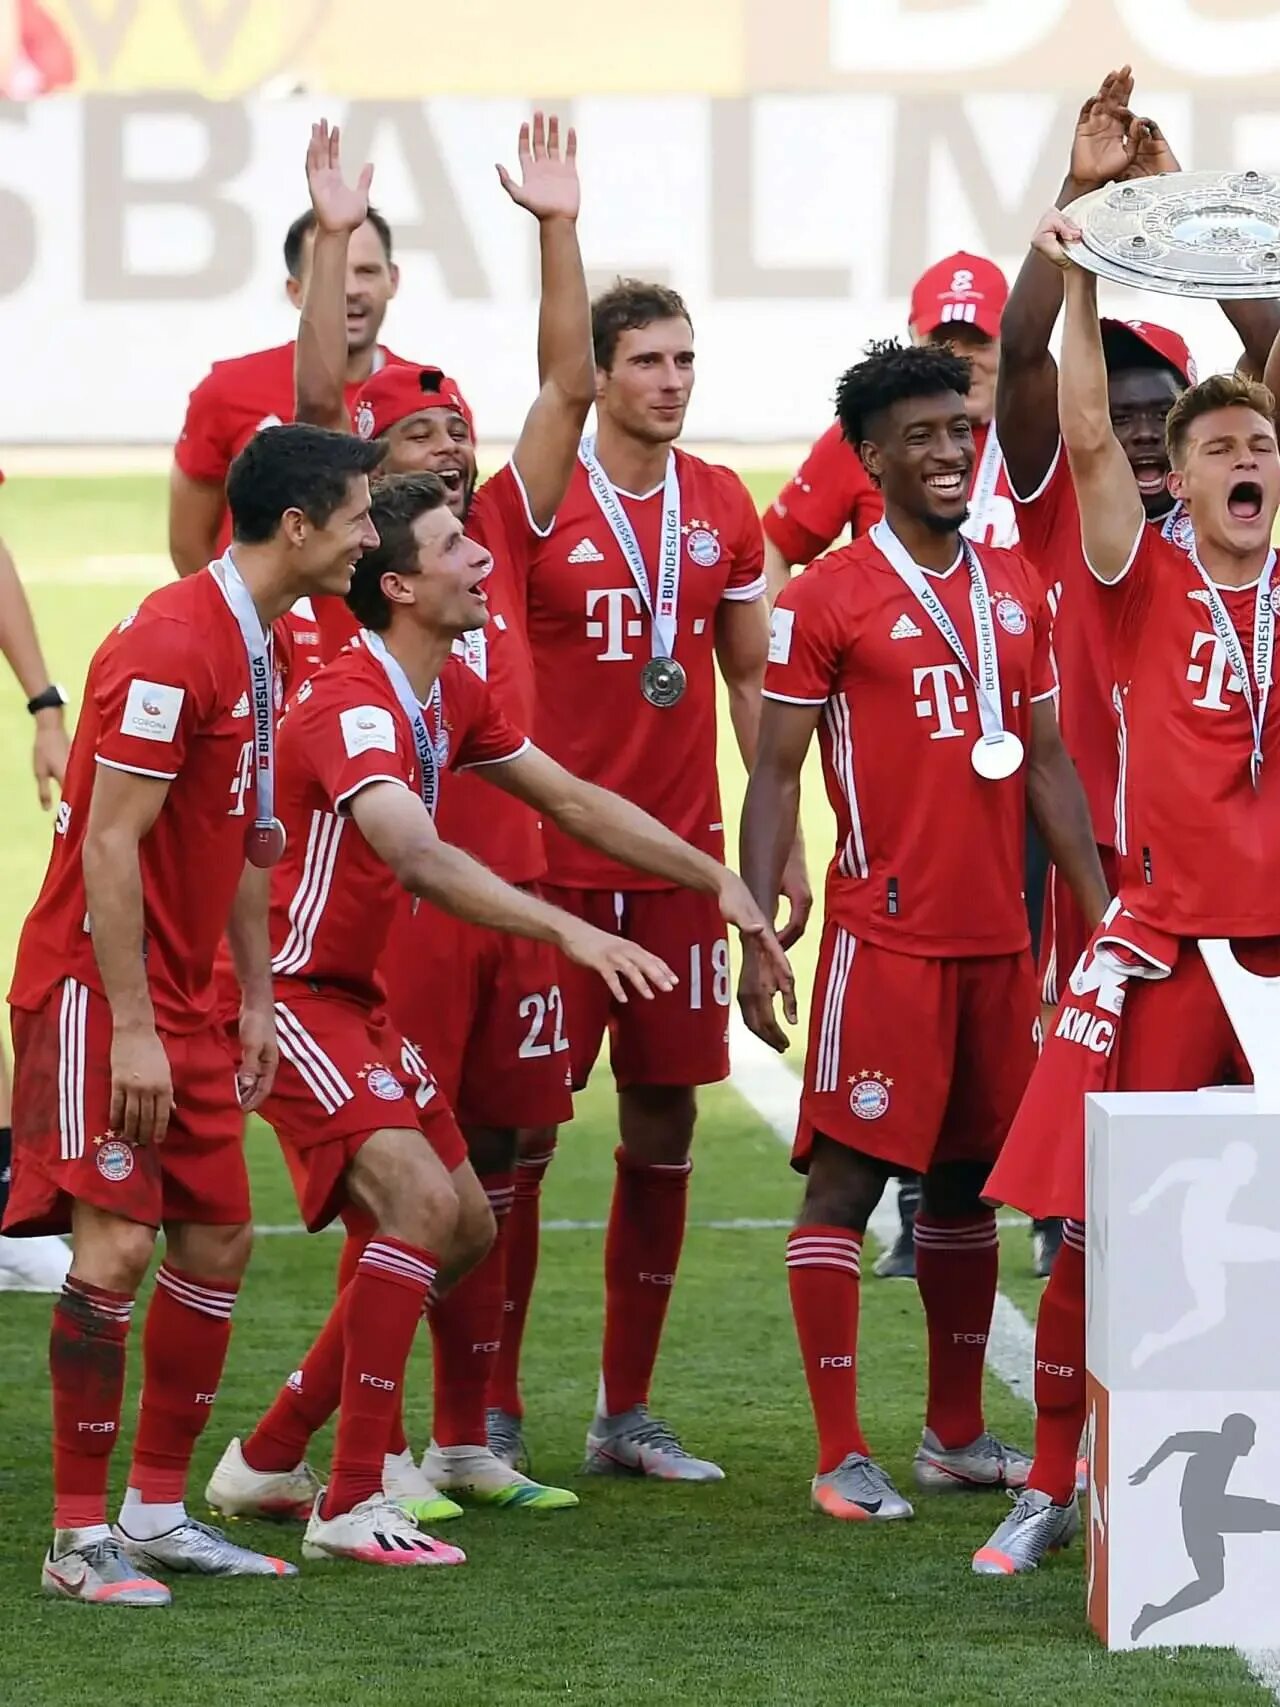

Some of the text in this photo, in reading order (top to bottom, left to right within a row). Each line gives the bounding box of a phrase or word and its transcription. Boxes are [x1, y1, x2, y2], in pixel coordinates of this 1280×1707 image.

[662, 509, 678, 599] BUNDESLIGA
[920, 589, 967, 664] NDESLIGA
[983, 623, 995, 690] DEUTSCHER
[1257, 593, 1271, 685] BUNDESLIGA
[253, 656, 270, 753] BUNDESLIGA
[414, 716, 435, 804] BUNDESLIGA
[690, 938, 731, 1010] 18
[518, 985, 570, 1059] 22
[639, 1272, 675, 1286] FCB
[820, 1355, 852, 1369] FCB
[953, 1333, 987, 1345] FCB
[1036, 1360, 1075, 1378] FCB
[195, 1392, 216, 1404] FC
[360, 1373, 395, 1392] FCB
[78, 1421, 115, 1433] FCB
